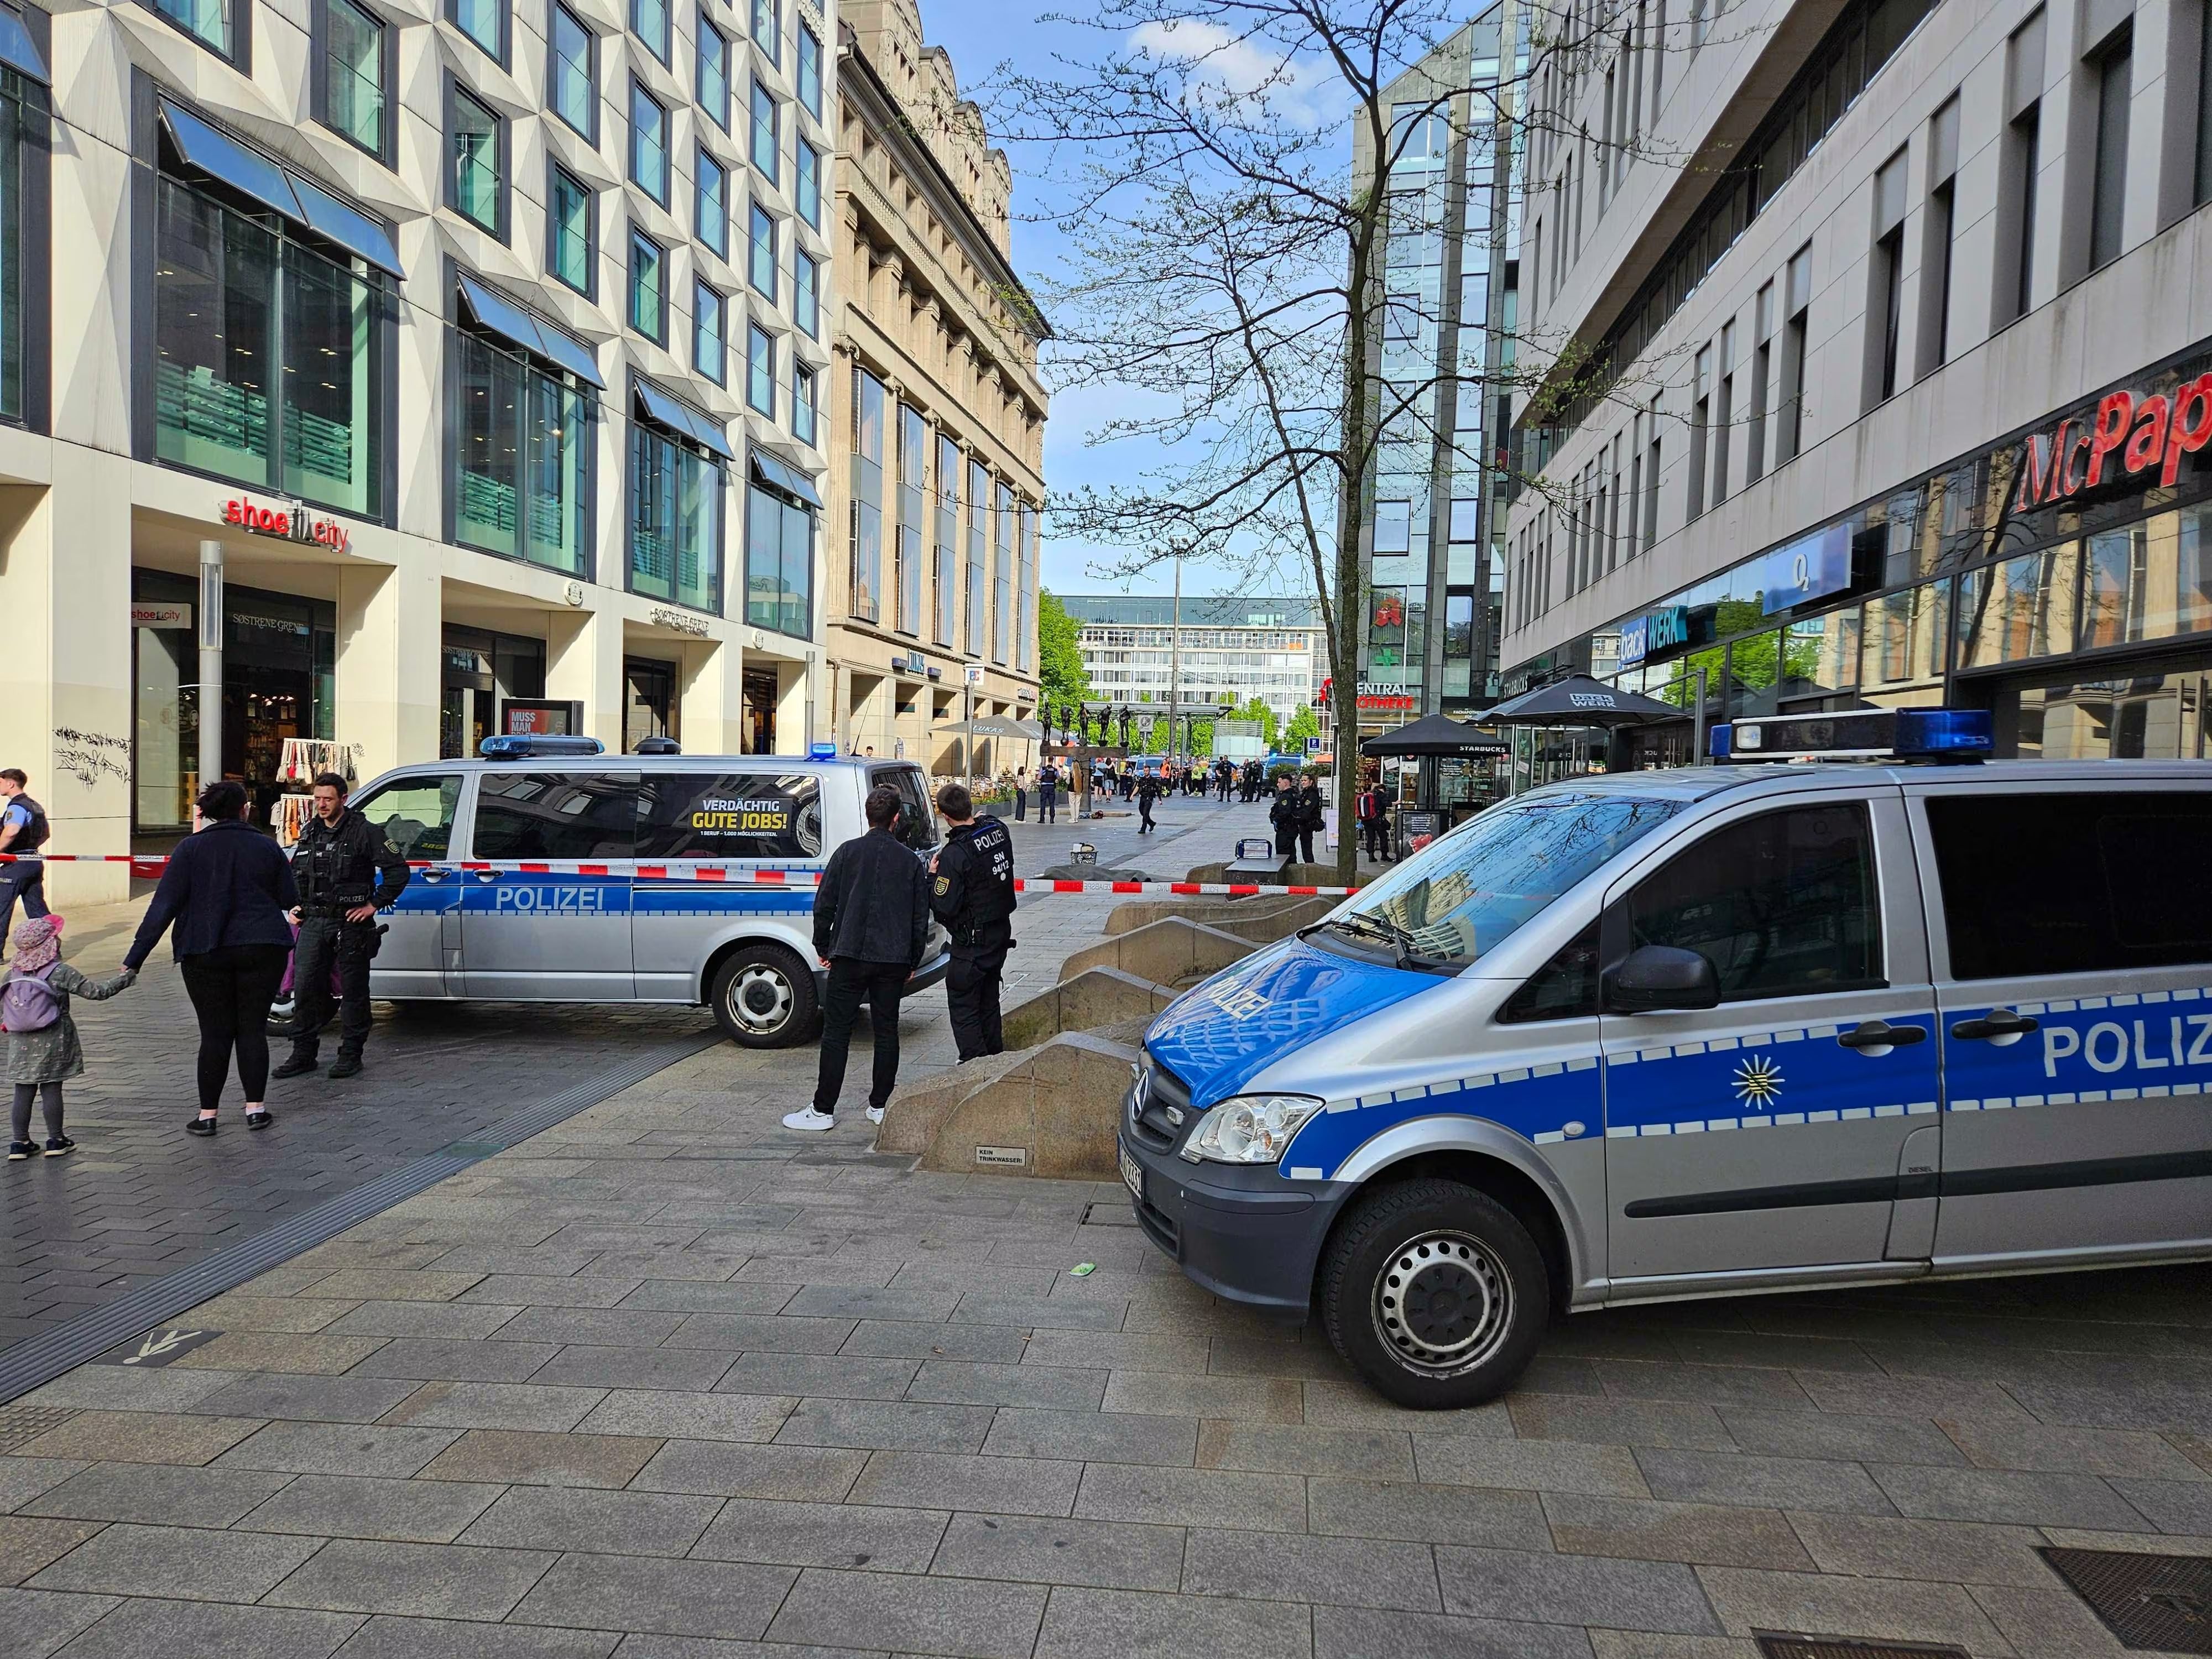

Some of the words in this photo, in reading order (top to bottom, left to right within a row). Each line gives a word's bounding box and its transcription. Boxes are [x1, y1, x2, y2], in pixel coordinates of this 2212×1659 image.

[227, 497, 289, 534] shoe
[314, 519, 348, 553] city
[132, 610, 155, 619] shoe
[164, 610, 180, 622] city
[233, 614, 276, 629] SØSTRENE
[1621, 621, 1646, 661] back
[1648, 604, 1679, 652] WERK
[1357, 682, 1409, 696] ENTRAL
[1357, 695, 1414, 709] OTHEKE
[512, 712, 535, 722] MUSS
[512, 722, 531, 732] MAN
[973, 725, 1004, 733] LUKAS
[703, 798, 780, 811] VERDÄCHTIG
[692, 812, 737, 828] GUTE
[741, 813, 787, 830] JOBS!
[973, 829, 1005, 851] POLIZEI
[994, 851, 1005, 863] SN
[992, 860, 1010, 875] 94/12
[496, 887, 603, 910] POLIZEI
[1205, 975, 1274, 1021] POLIZEI
[2043, 1014, 2212, 1077] POLIZ
